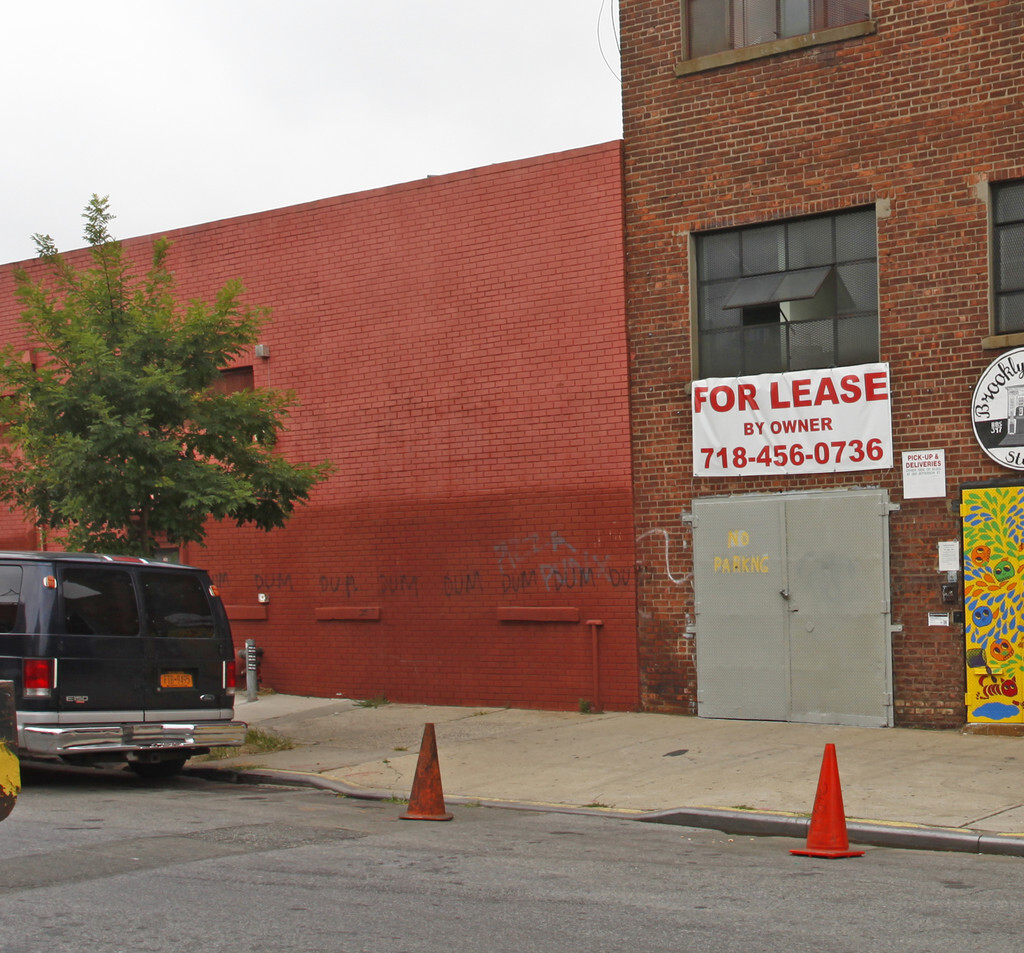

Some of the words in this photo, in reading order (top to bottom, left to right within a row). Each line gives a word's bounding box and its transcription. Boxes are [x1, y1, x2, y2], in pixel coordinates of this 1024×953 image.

[694, 383, 760, 413] FOR
[769, 371, 889, 410] LEASE
[743, 421, 765, 436] BY
[770, 417, 833, 435] OWNER
[700, 437, 884, 469] 718-456-0736
[727, 530, 750, 548] NO
